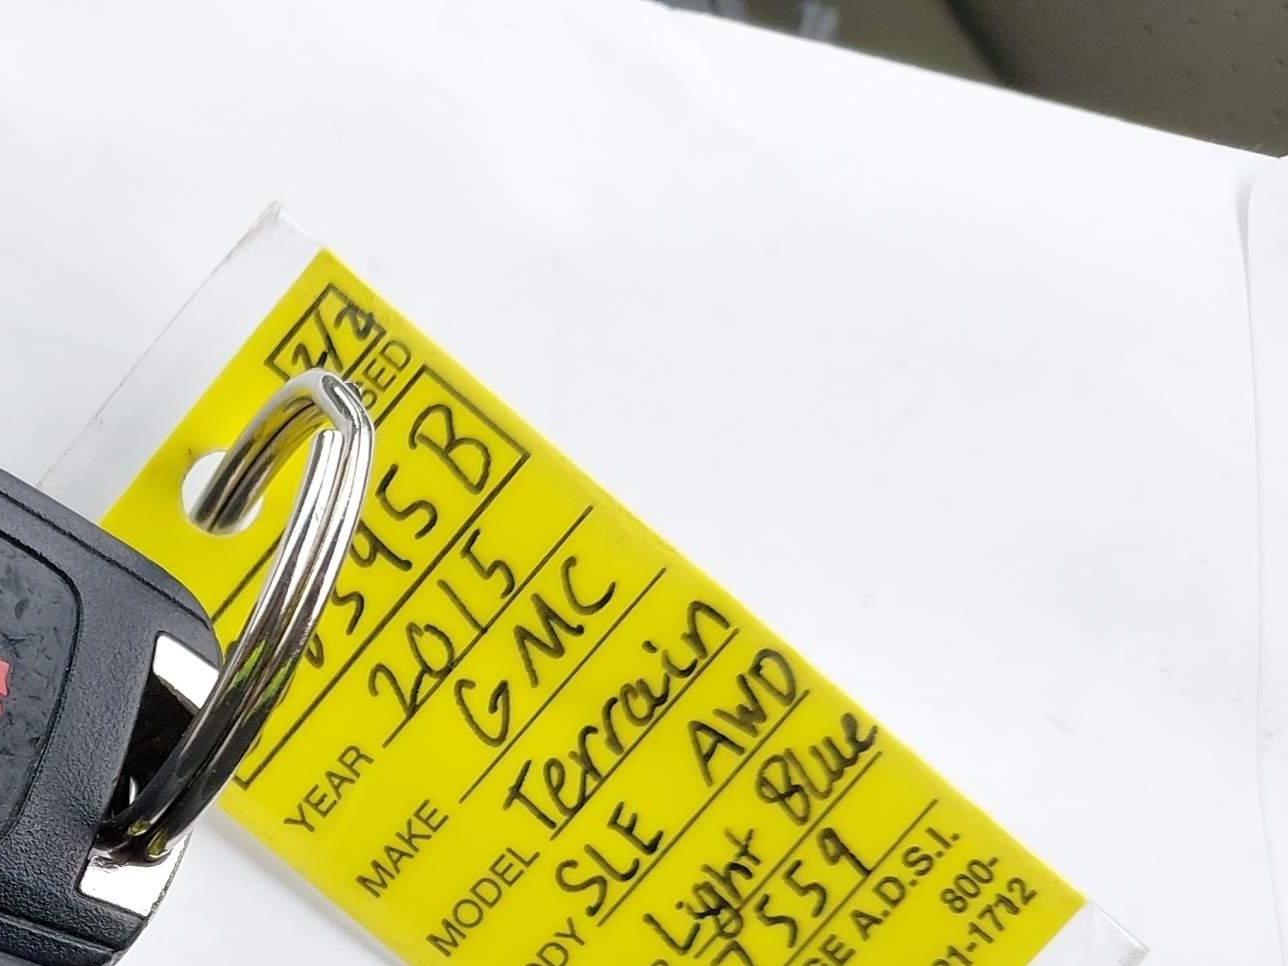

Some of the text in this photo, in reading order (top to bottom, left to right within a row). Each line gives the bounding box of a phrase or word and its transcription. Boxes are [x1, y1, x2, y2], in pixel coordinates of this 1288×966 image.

[357, 339, 412, 412] SED
[368, 528, 516, 718] 2015
[454, 555, 616, 747] GMC
[502, 600, 732, 830] Terrain
[283, 744, 375, 833] YEAR
[554, 647, 797, 917] SLE AWD
[642, 711, 878, 955] Light Blue
[355, 798, 449, 898] MAKE
[425, 846, 541, 958] MODEL
[851, 825, 961, 941] A.D.S.I.
[939, 855, 999, 914] 800-
